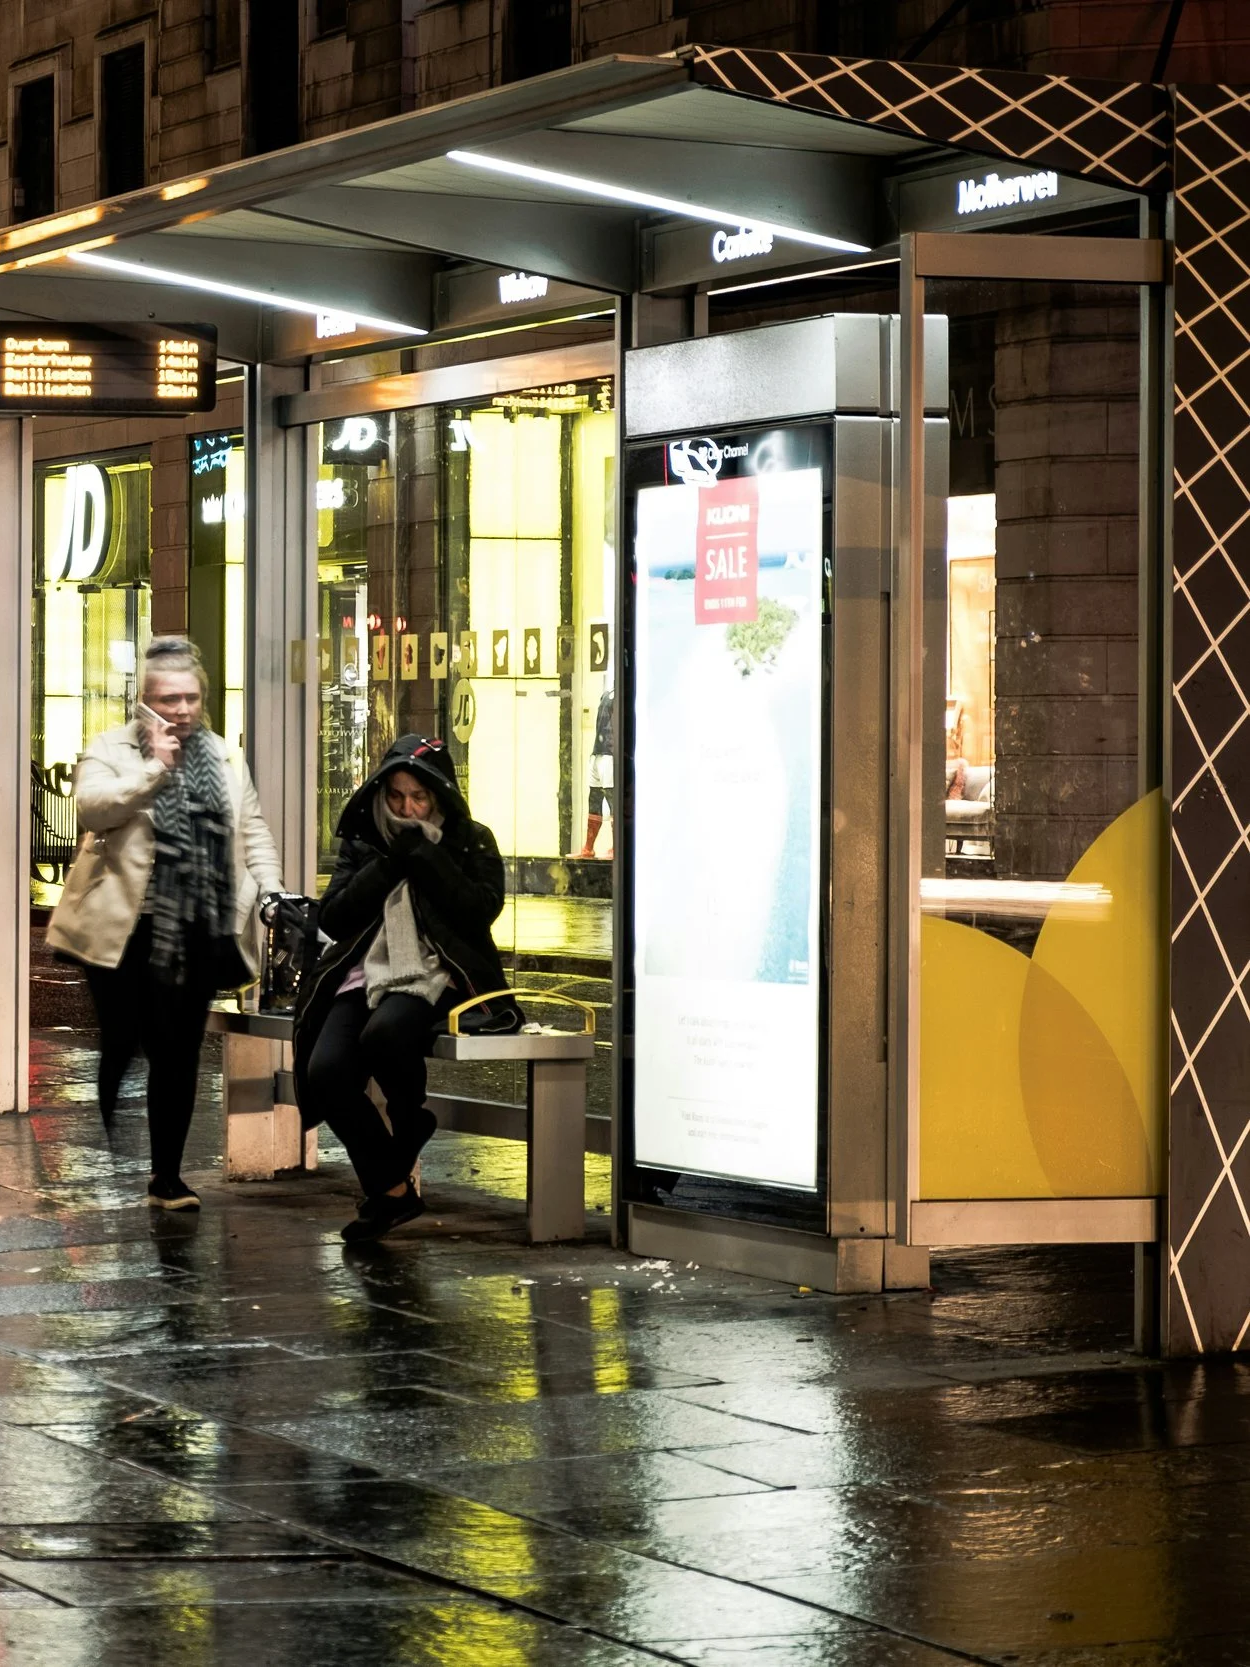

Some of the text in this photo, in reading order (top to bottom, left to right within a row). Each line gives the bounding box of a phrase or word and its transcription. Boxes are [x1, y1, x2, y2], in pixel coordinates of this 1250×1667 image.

[332, 417, 378, 451] JD
[724, 443, 749, 458] Channel
[50, 463, 107, 582] JD
[705, 546, 748, 581] SALE
